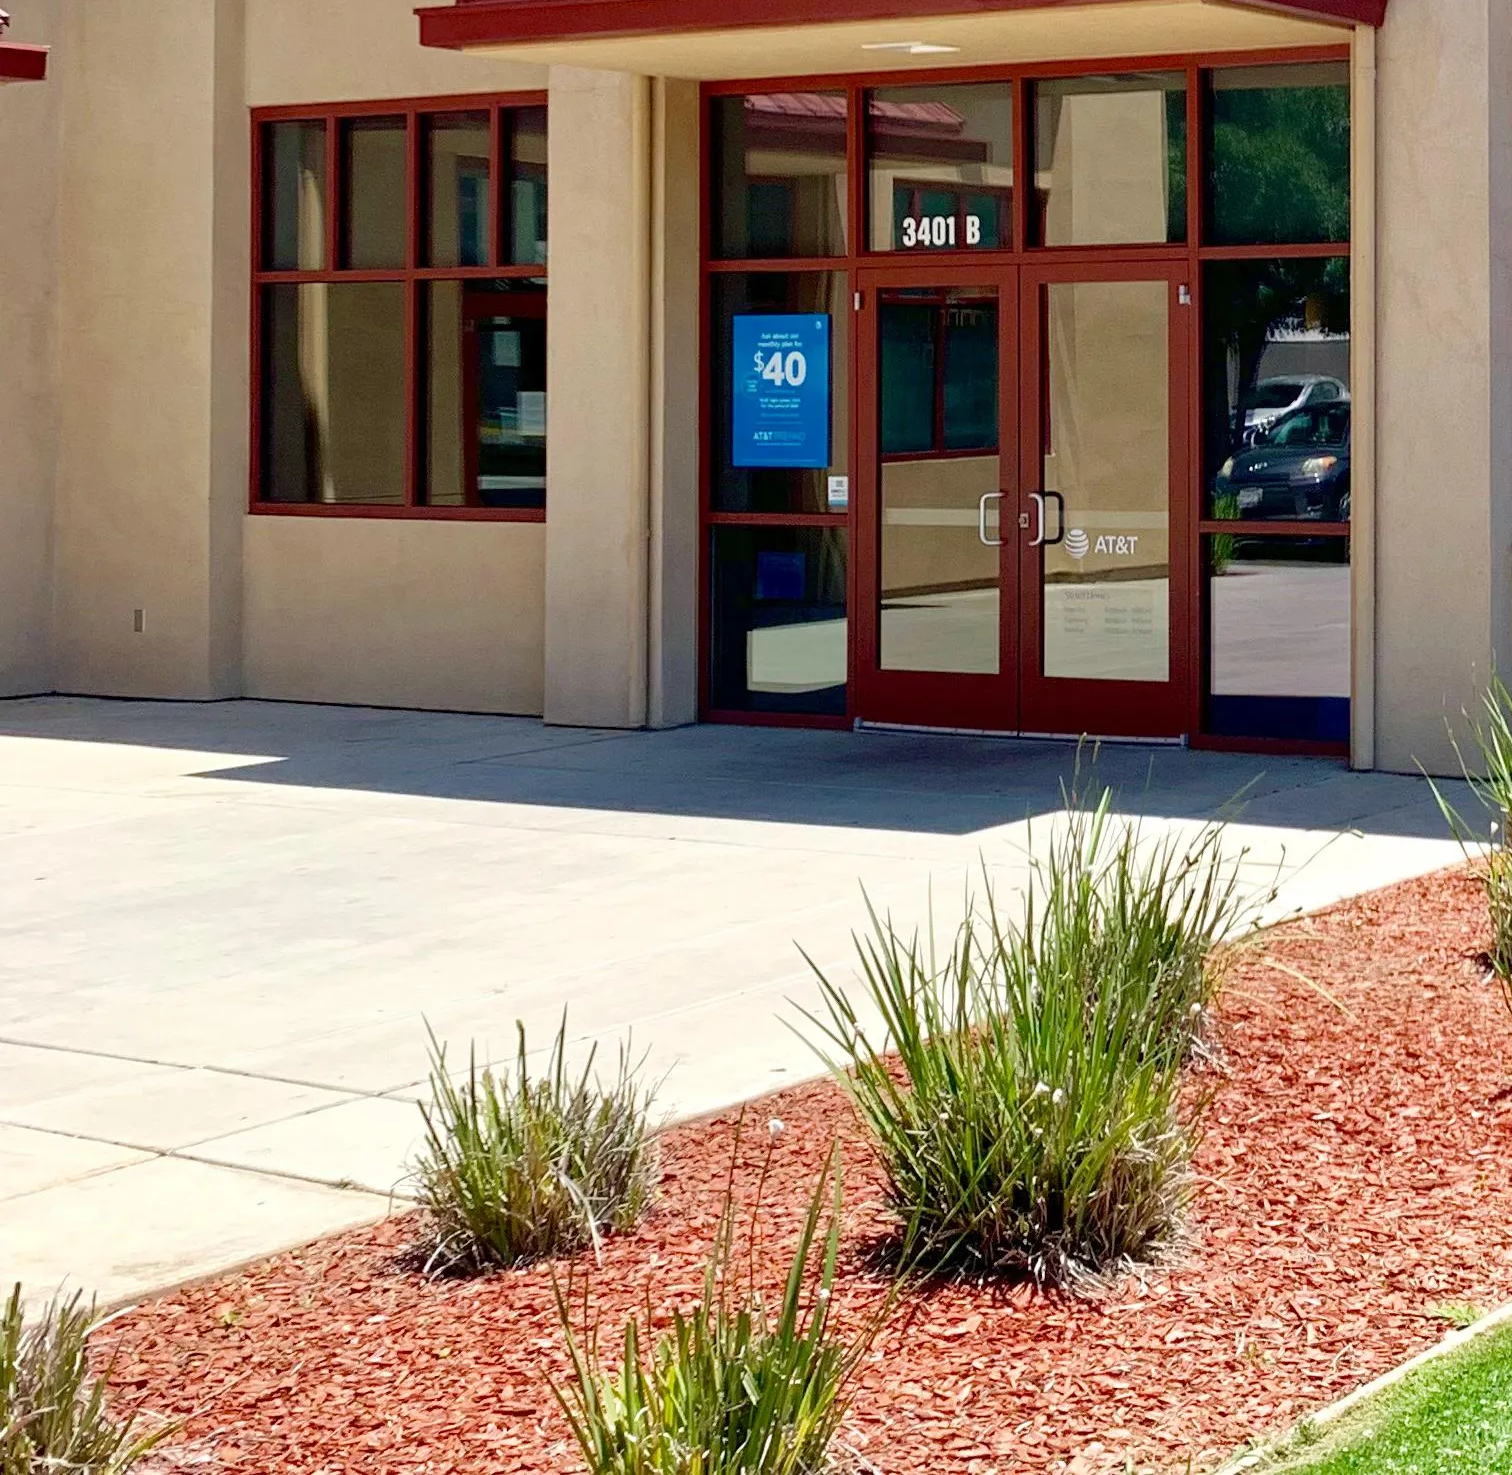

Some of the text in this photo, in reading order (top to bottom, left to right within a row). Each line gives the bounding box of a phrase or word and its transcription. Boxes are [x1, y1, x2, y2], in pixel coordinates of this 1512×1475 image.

[902, 215, 981, 247] 3401 B
[753, 350, 807, 387] $40
[753, 431, 773, 441] AT&T
[1094, 535, 1138, 554] AT&T
